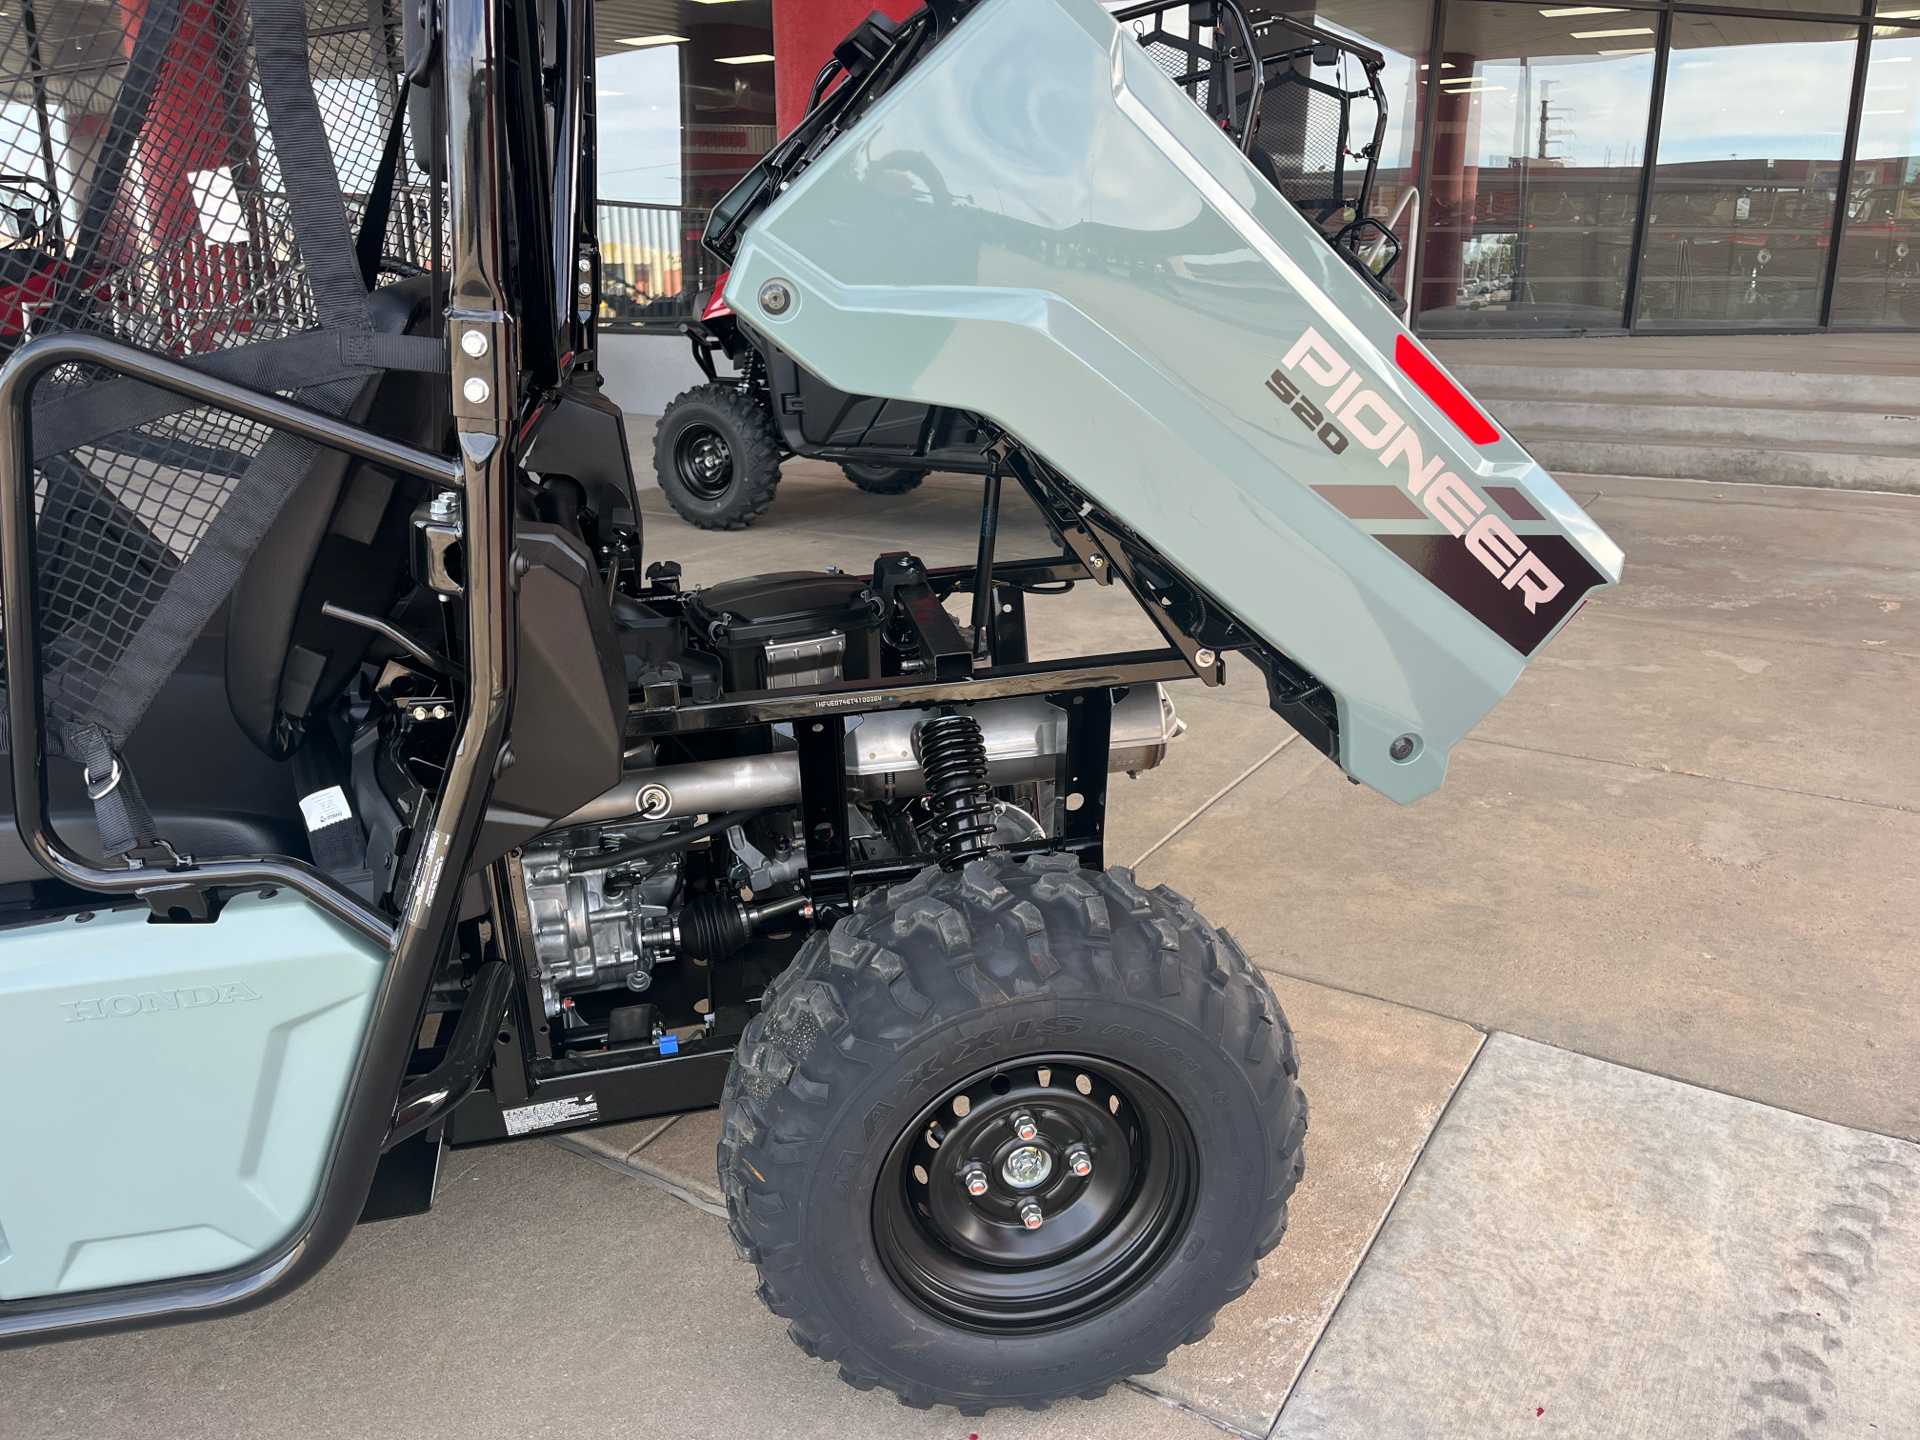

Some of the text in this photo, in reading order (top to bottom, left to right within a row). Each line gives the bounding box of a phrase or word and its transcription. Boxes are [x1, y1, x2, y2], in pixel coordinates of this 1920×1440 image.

[1265, 369, 1349, 456] 520
[1281, 326, 1565, 615] PIONEER
[60, 979, 262, 1024] HONDA
[830, 1014, 1202, 1202] MAXXIS M978H
